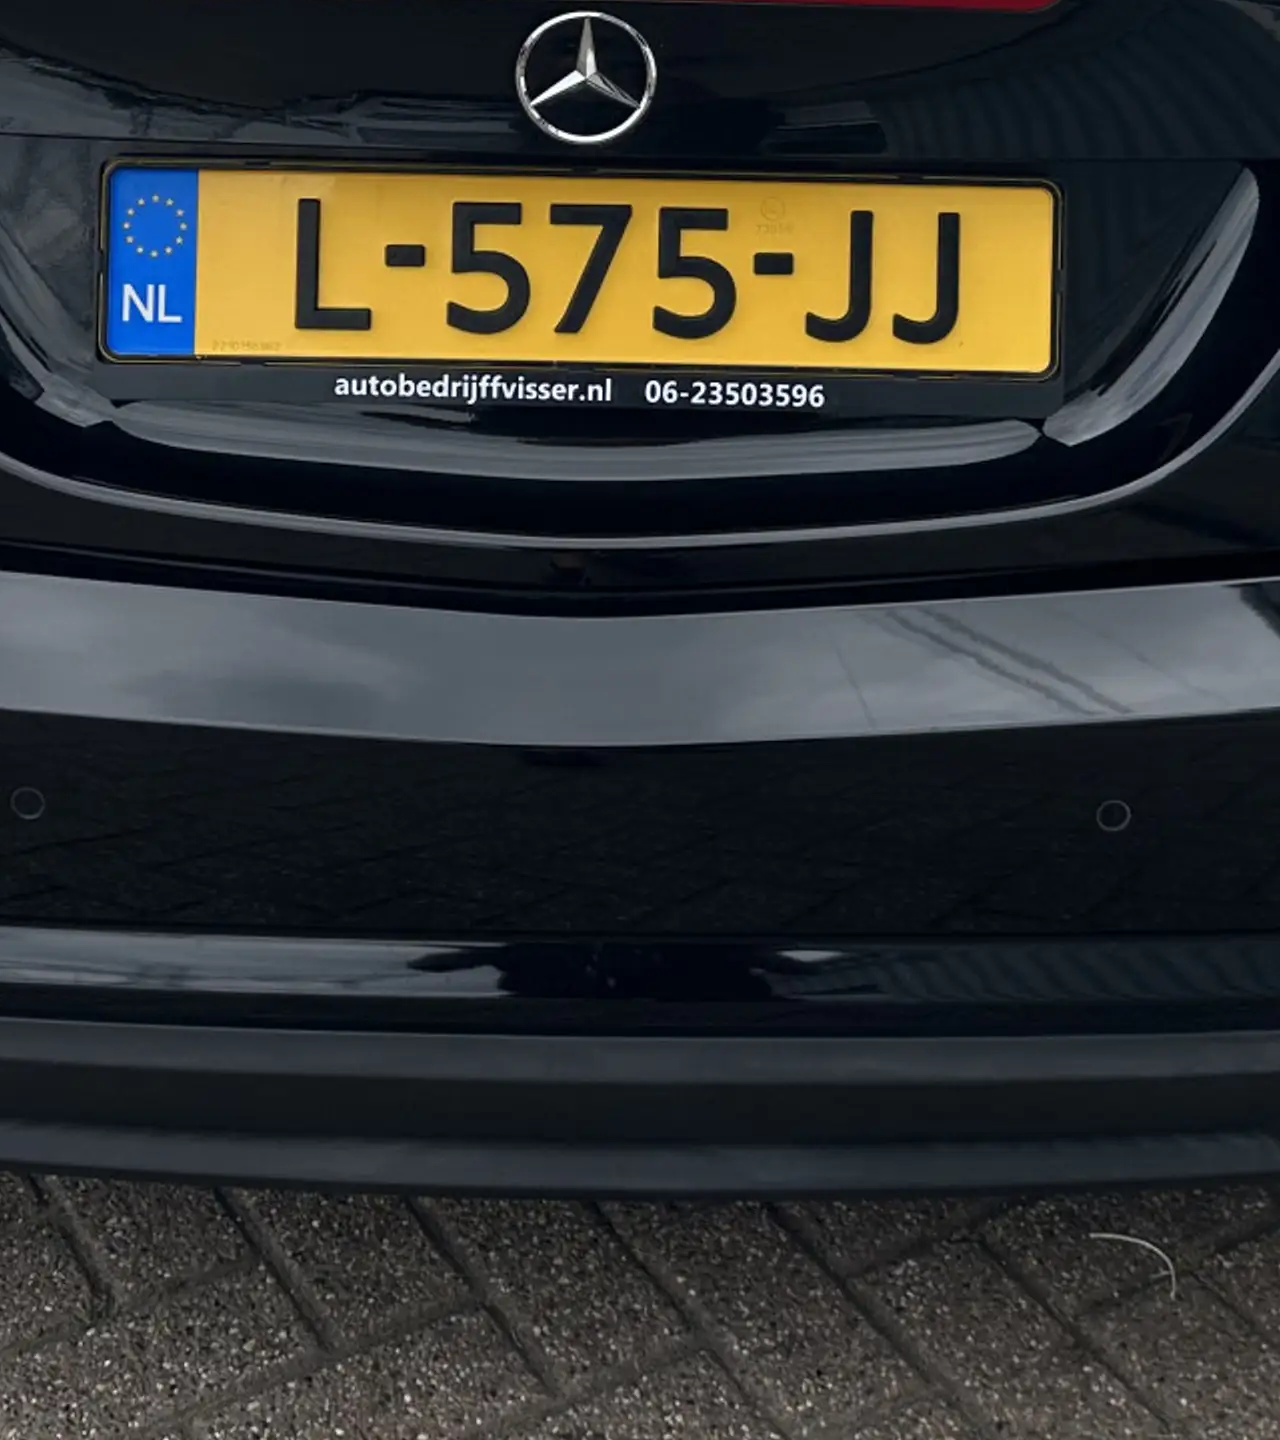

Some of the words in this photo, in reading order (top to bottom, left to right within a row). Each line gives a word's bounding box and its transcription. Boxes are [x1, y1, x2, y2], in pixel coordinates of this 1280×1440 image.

[294, 197, 961, 345] L-575-JJ
[122, 284, 183, 323] NL
[334, 373, 613, 404] autobedrijffvisser.nl
[644, 379, 826, 408] 06-23503596
